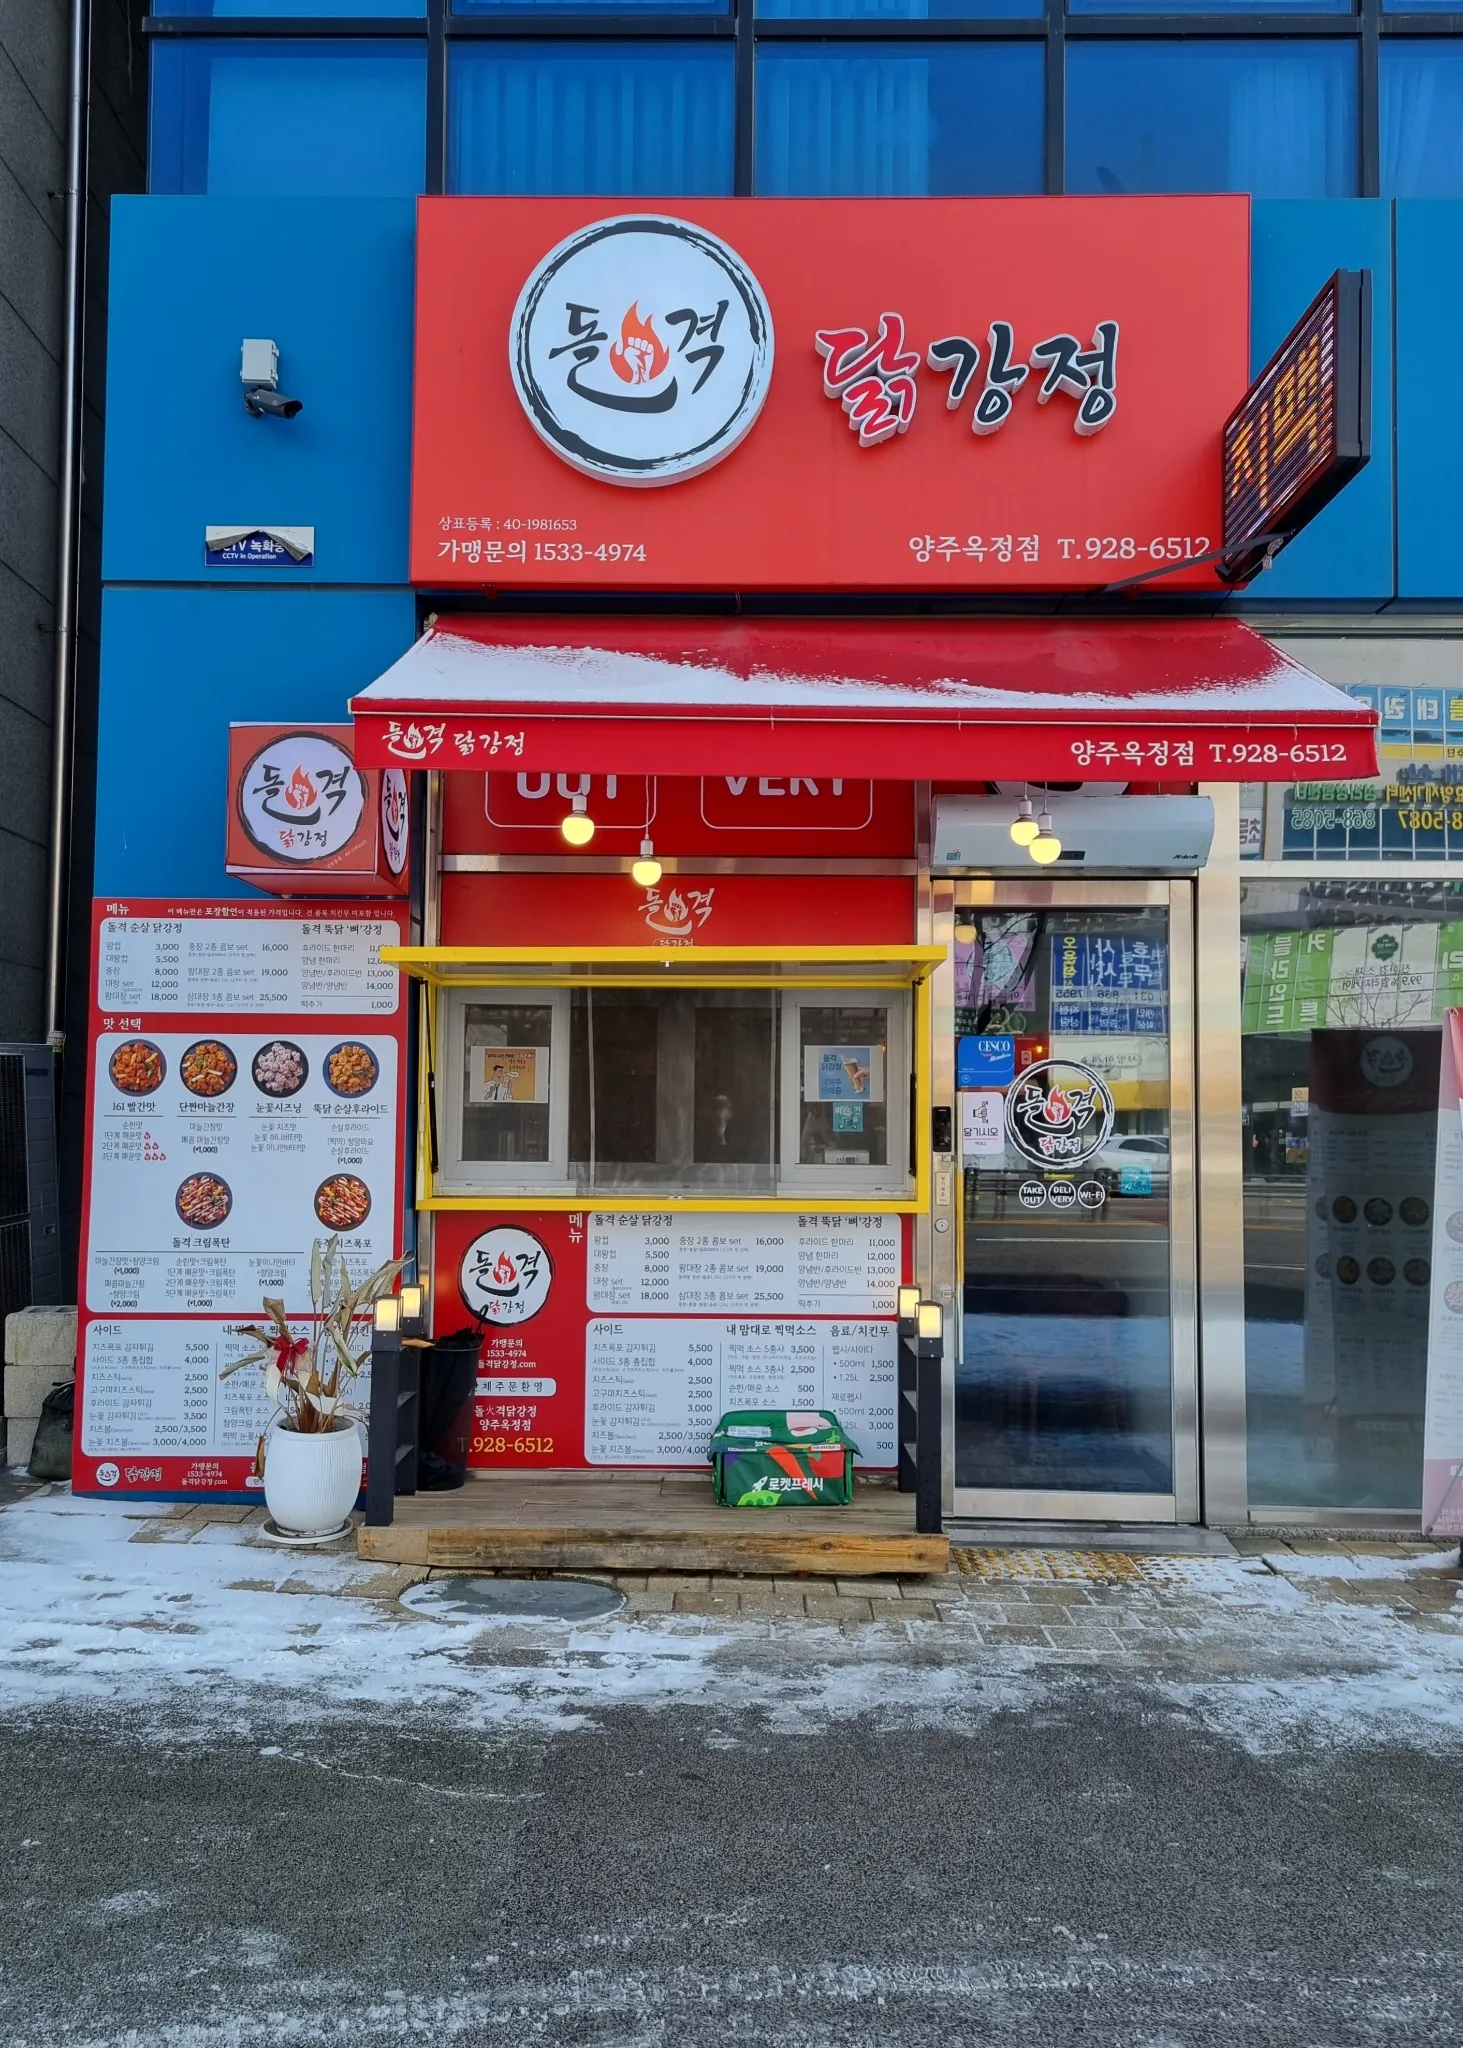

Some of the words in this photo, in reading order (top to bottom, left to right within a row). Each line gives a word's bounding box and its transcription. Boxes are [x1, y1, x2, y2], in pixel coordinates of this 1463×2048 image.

[547, 300, 730, 414] 돌격
[814, 311, 1120, 448] 닭강정
[439, 517, 492, 531] 상표등록
[503, 519, 577, 530] 40-1981653
[438, 539, 526, 563] 가맹문의
[535, 543, 646, 562] 1533-4974
[909, 535, 1041, 564] 양주옥정점
[1057, 537, 1211, 561] T.928-6512
[382, 721, 446, 759] 돌격
[454, 730, 525, 756] 닭강정
[1071, 741, 1194, 766] 양주옥정점
[1209, 744, 1347, 763] T.928-6512
[252, 764, 350, 825] 돌격
[279, 829, 327, 848] 닭강정
[107, 903, 129, 915] 메뉴
[205, 907, 244, 917] 포장할인이
[638, 887, 715, 935] 돌격
[108, 922, 127, 933] 돌격
[130, 922, 149, 933] 순살
[153, 922, 182, 933] 닭강정
[301, 924, 321, 935] 돌격
[324, 924, 344, 935] 뚝닭
[156, 943, 179, 951] 3,000
[262, 944, 288, 952] 16,000
[302, 944, 331, 952] 후라이드
[333, 944, 355, 952] 한마리
[106, 955, 128, 963] 대왕컵
[156, 956, 179, 964] 5,500
[155, 968, 178, 977] 8,000
[261, 969, 288, 977] 19,000
[151, 980, 178, 989] 12,000
[366, 982, 394, 990] 14,000
[151, 993, 178, 1001] 18,000
[260, 994, 287, 1002] 25,500
[371, 1001, 393, 1009] 1,000
[104, 1018, 115, 1030] 맛
[119, 1018, 141, 1030] 선택
[978, 1041, 1010, 1052] CESCO
[112, 1102, 125, 1110] 161
[128, 1102, 156, 1112] 빨간맛
[334, 1104, 388, 1114] 순살후라이드
[1017, 1085, 1098, 1136] 돌격
[964, 1128, 998, 1137] 당기시오
[1038, 1136, 1081, 1155] 닭강정
[1024, 1196, 1042, 1204] OUT
[595, 1214, 615, 1226] 돌격
[618, 1214, 639, 1226] 순살
[642, 1214, 673, 1226] 닭강정
[798, 1216, 818, 1228] 돌격
[821, 1216, 842, 1228] 뚝닭
[568, 1212, 583, 1244] 메뉴
[173, 1238, 191, 1248] 돌격
[645, 1237, 669, 1246] 3,000
[756, 1238, 784, 1246] 16,000
[799, 1238, 829, 1246] 후라이드
[831, 1238, 853, 1247] 한마리
[869, 1239, 895, 1247] 11,000
[594, 1250, 616, 1259] 대왕컵
[645, 1251, 669, 1259] 5,500
[798, 1252, 813, 1260] 양념
[816, 1252, 838, 1261] 한마리
[867, 1253, 895, 1261] 12,000
[469, 1249, 541, 1297] 돌격
[645, 1264, 669, 1273] 8,000
[756, 1265, 784, 1274] 19,000
[867, 1266, 895, 1275] 13,000
[641, 1278, 669, 1287] 12,000
[866, 1280, 895, 1288] 14,000
[641, 1292, 669, 1300] 18,000
[755, 1293, 783, 1301] 25,500
[488, 1300, 525, 1315] 닭강정
[872, 1301, 895, 1309] 1,000
[93, 1325, 122, 1336] 사이드
[593, 1324, 623, 1335] 사이드
[727, 1324, 736, 1335] 내
[739, 1324, 771, 1336] 맘대로
[774, 1325, 817, 1335] 찍먹소스
[830, 1326, 890, 1337] 음료/치킨무
[185, 1344, 209, 1352] 5,500
[491, 1339, 523, 1348] 가맹문의
[487, 1349, 527, 1357] 1533-4974
[689, 1344, 713, 1353] 5,500
[791, 1345, 815, 1354] 3,500
[184, 1357, 209, 1365] 4,000
[478, 1360, 536, 1369] 돌격닭강정.com
[688, 1358, 712, 1366] 4,000
[839, 1359, 865, 1367] 500ml
[871, 1360, 894, 1369] 1,500
[791, 1366, 814, 1374] 2,500
[688, 1377, 712, 1385] 2,500
[839, 1373, 859, 1382] 1.25L
[870, 1374, 894, 1383] 2,500
[798, 1385, 814, 1393] 500
[688, 1390, 712, 1399] 2,500
[184, 1400, 207, 1408] 3,000
[792, 1398, 814, 1407] 1,500
[688, 1404, 712, 1413] 3,000
[839, 1407, 864, 1415] 500ml
[869, 1408, 893, 1416] 2,000
[480, 1419, 531, 1431] 양주옥정점
[688, 1418, 712, 1427] 3,500
[869, 1422, 893, 1430] 3,000
[155, 1425, 207, 1434] 2,500/3,500
[153, 1438, 206, 1447] 3,000/4,000
[877, 1442, 893, 1450] 500
[191, 1462, 219, 1470] 가맹문의
[188, 1470, 223, 1478] 1533-4974
[769, 1478, 824, 1491] 로켓프레시
